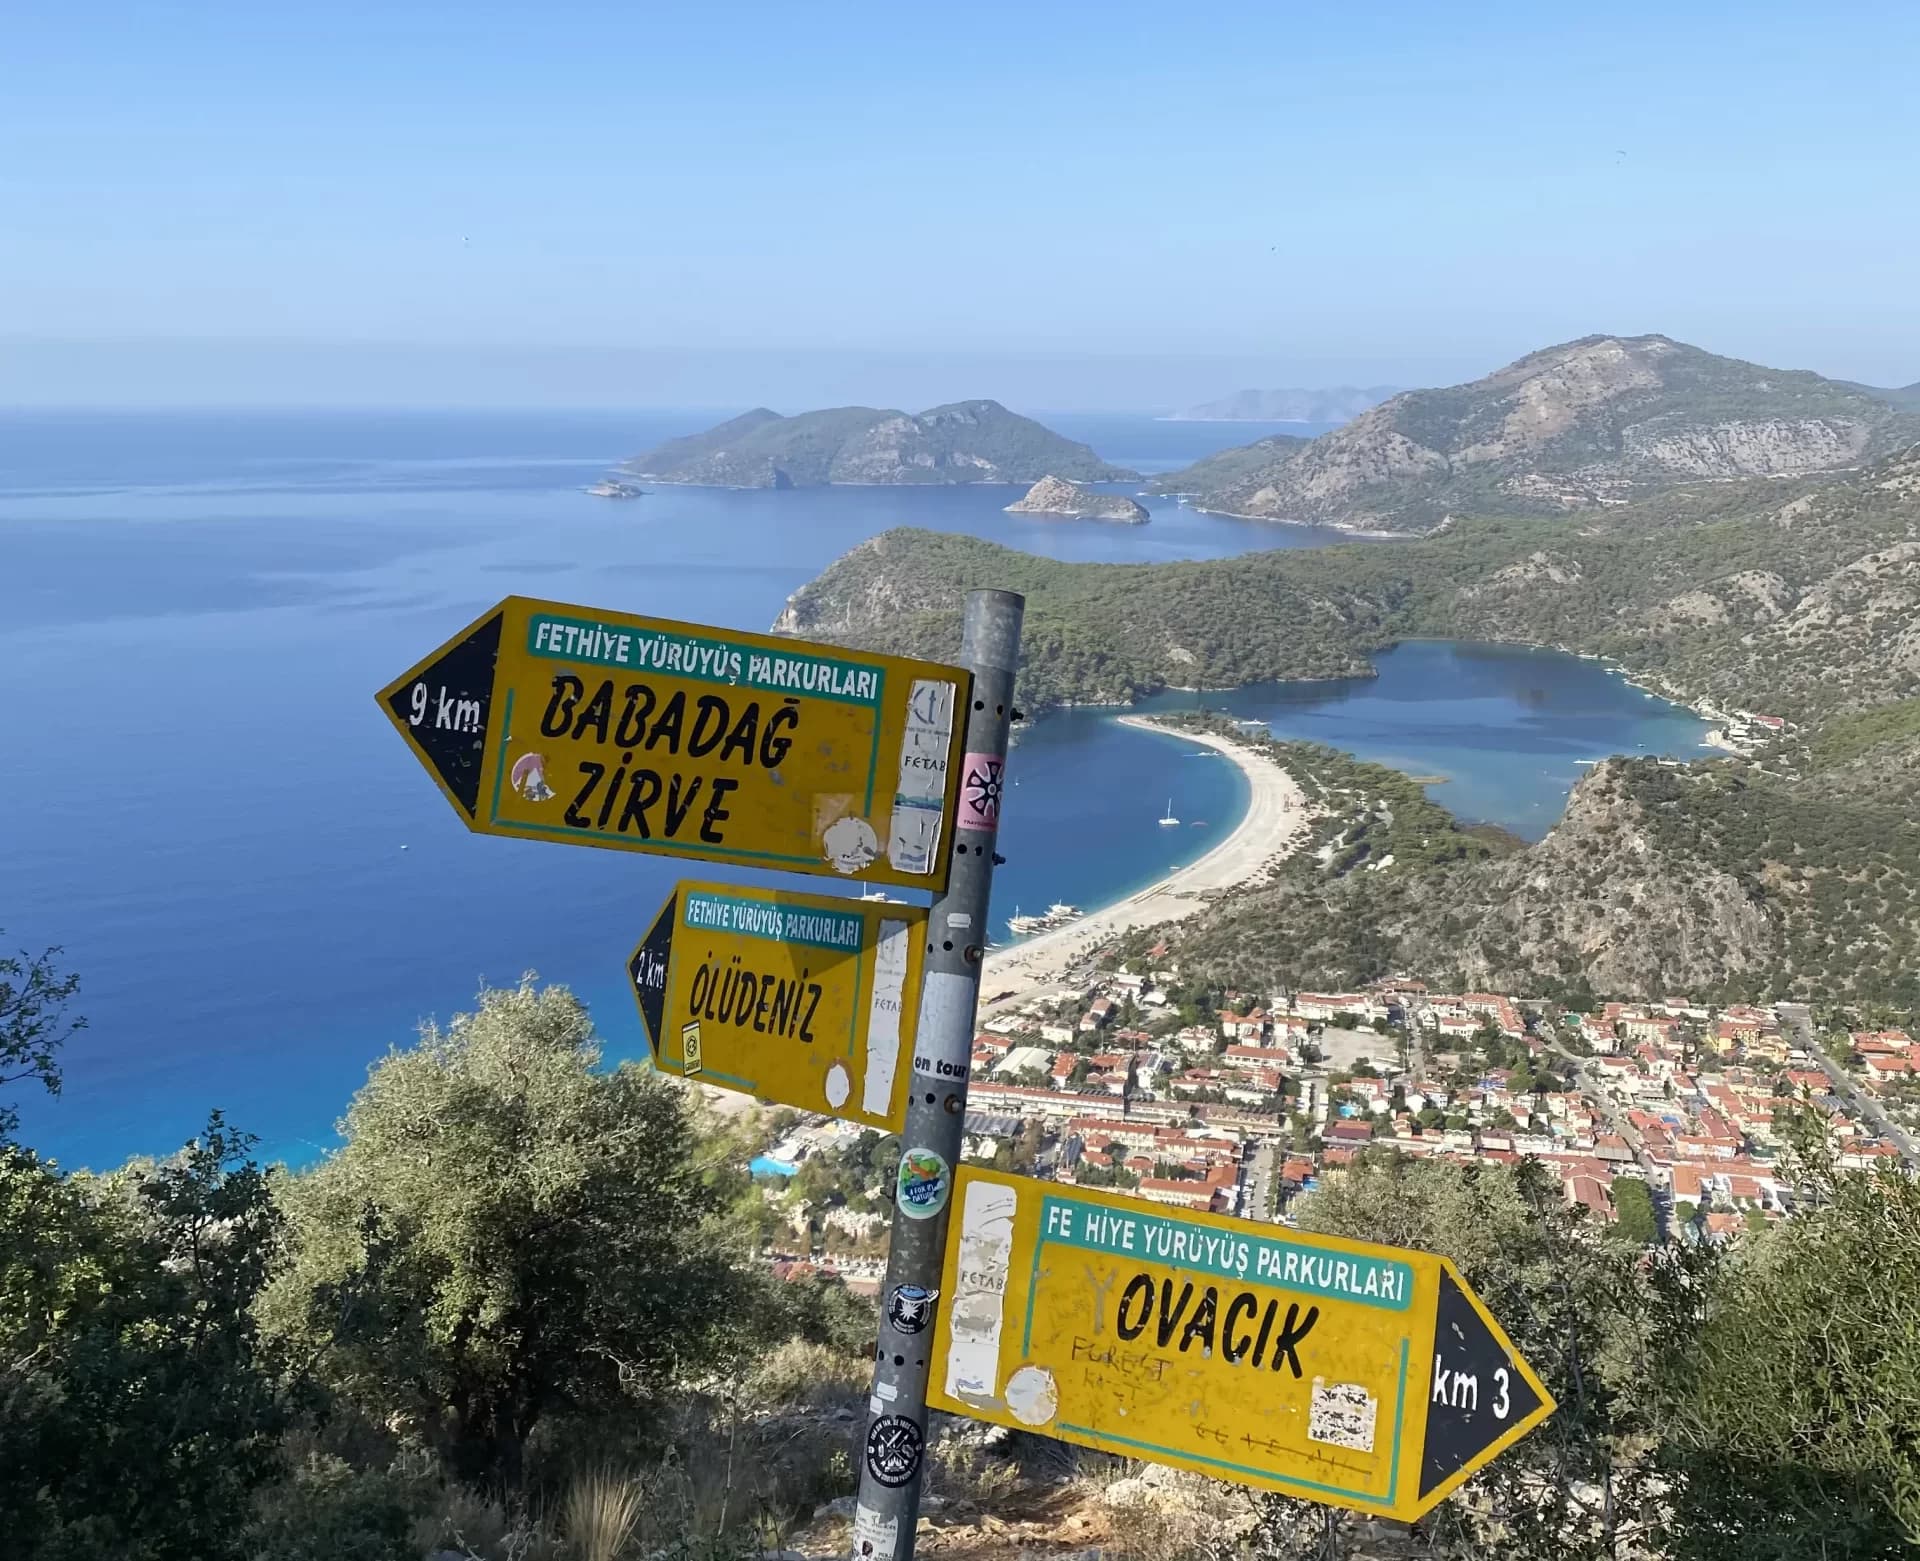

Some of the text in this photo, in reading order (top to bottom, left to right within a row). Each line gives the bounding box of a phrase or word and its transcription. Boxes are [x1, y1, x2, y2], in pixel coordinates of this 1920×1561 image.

[535, 622, 878, 700] FETHİYE YÜRÜYÜŞ PARKURLARI
[409, 682, 480, 733] 9 km
[541, 675, 800, 769] BABADAĞ
[564, 751, 739, 843] ZİRVE
[688, 897, 860, 946] FETHİYE YÜRÜYÜŞ PARKURLARI
[637, 952, 666, 988] 2 km
[915, 1055, 967, 1079] on tour
[961, 1271, 1003, 1290] FETAB
[1143, 1221, 1249, 1279] YÜRÜYÜŞ
[1257, 1246, 1404, 1302] PARKURLARI
[1116, 1273, 1320, 1379] OVACIK
[1432, 1354, 1510, 1420] km 3
